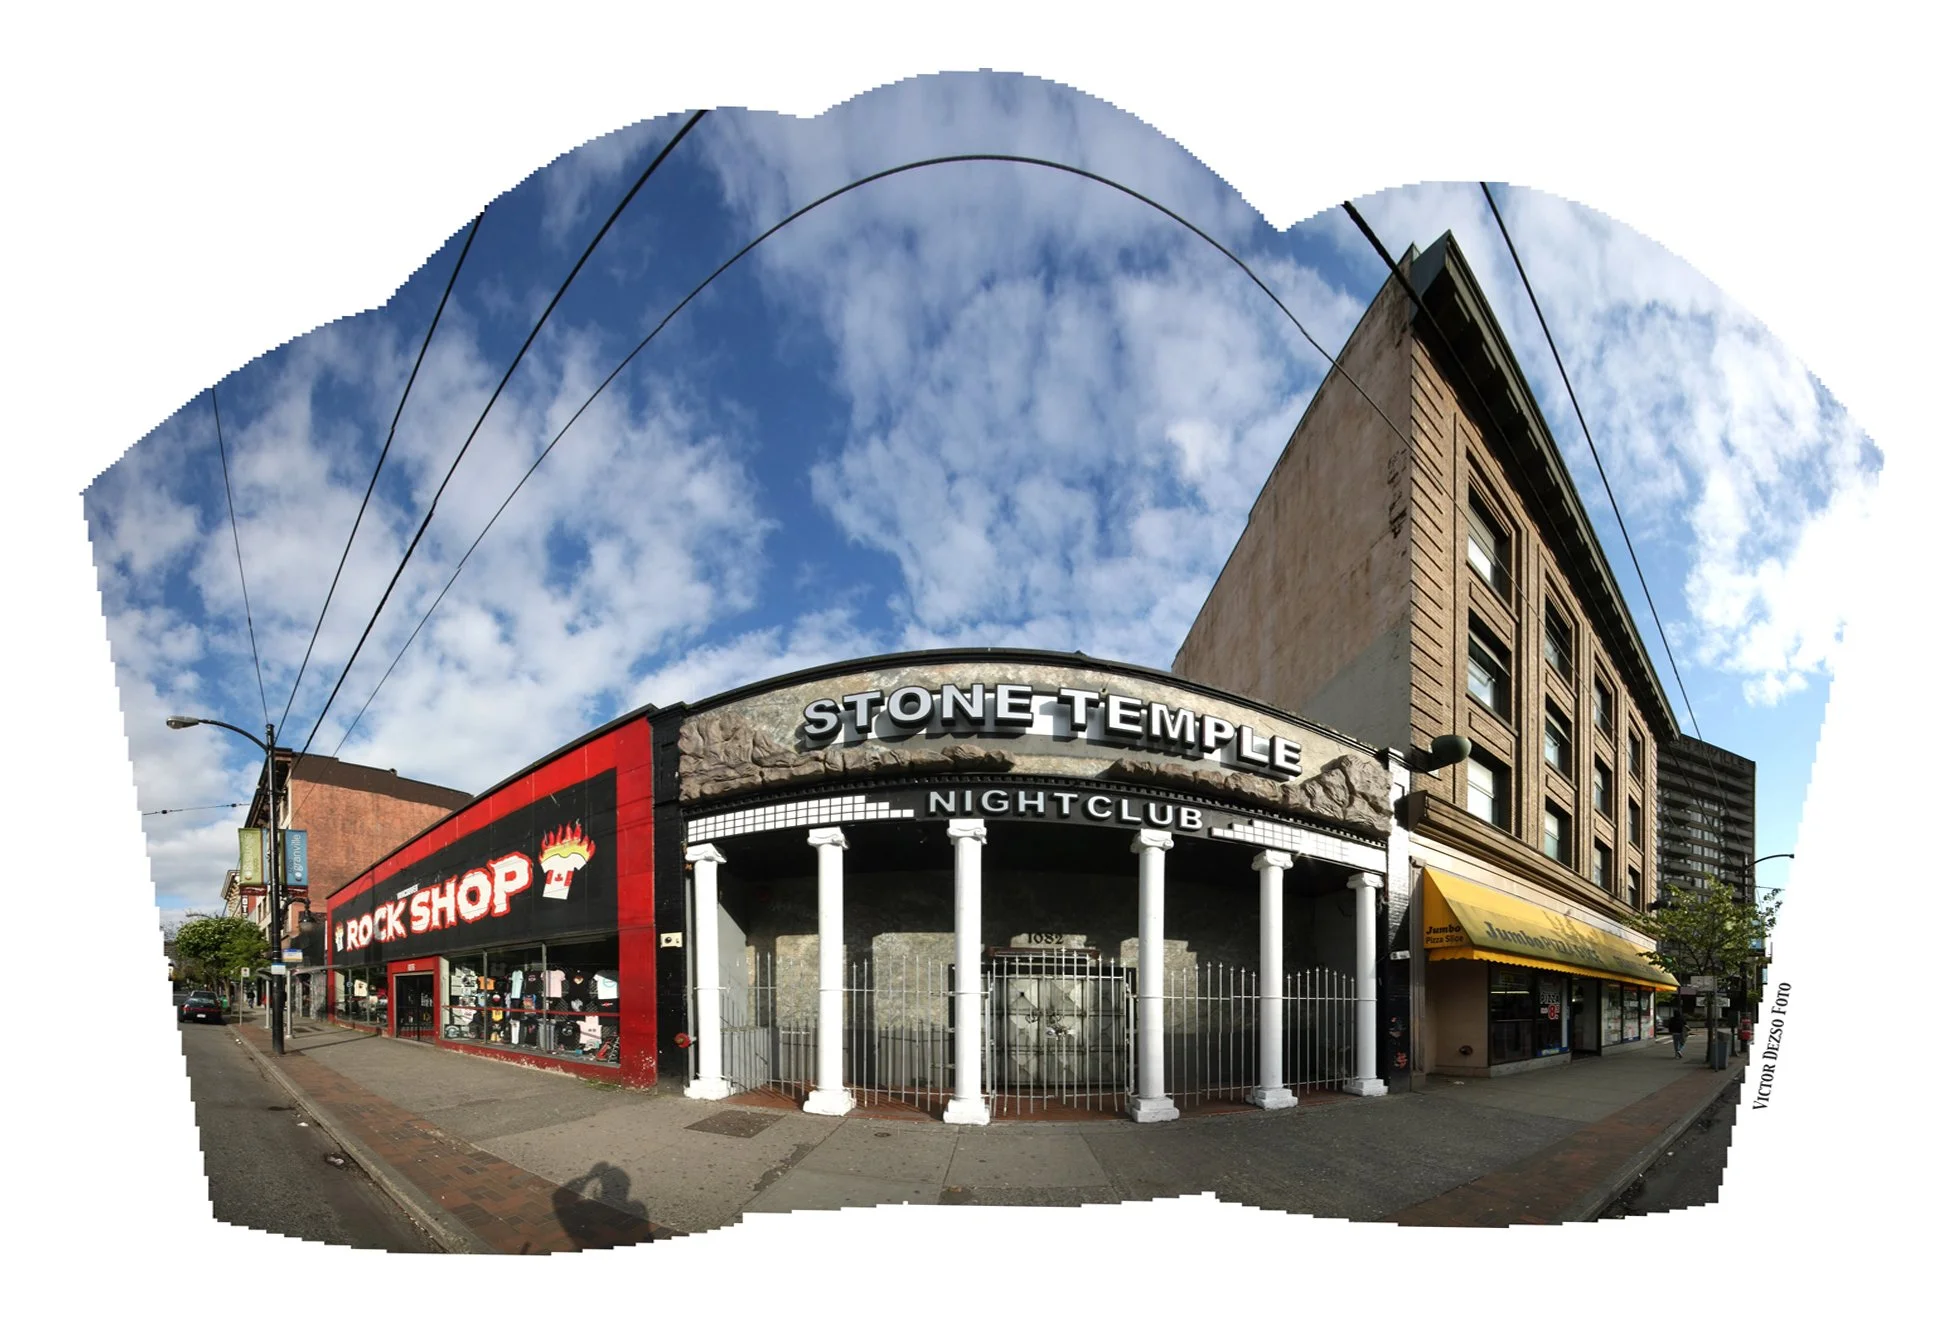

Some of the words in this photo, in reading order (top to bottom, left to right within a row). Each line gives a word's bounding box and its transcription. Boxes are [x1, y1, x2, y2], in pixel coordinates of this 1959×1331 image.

[802, 683, 1034, 740] STONE
[1058, 685, 1303, 776] TEMPLE
[928, 790, 1204, 832] NIGHTCLUB
[346, 899, 408, 951] ROCK
[410, 851, 534, 934] SHOP
[1028, 932, 1064, 945] 1082
[1426, 925, 1461, 935] Jumbo
[1484, 921, 1544, 950] Jumbo
